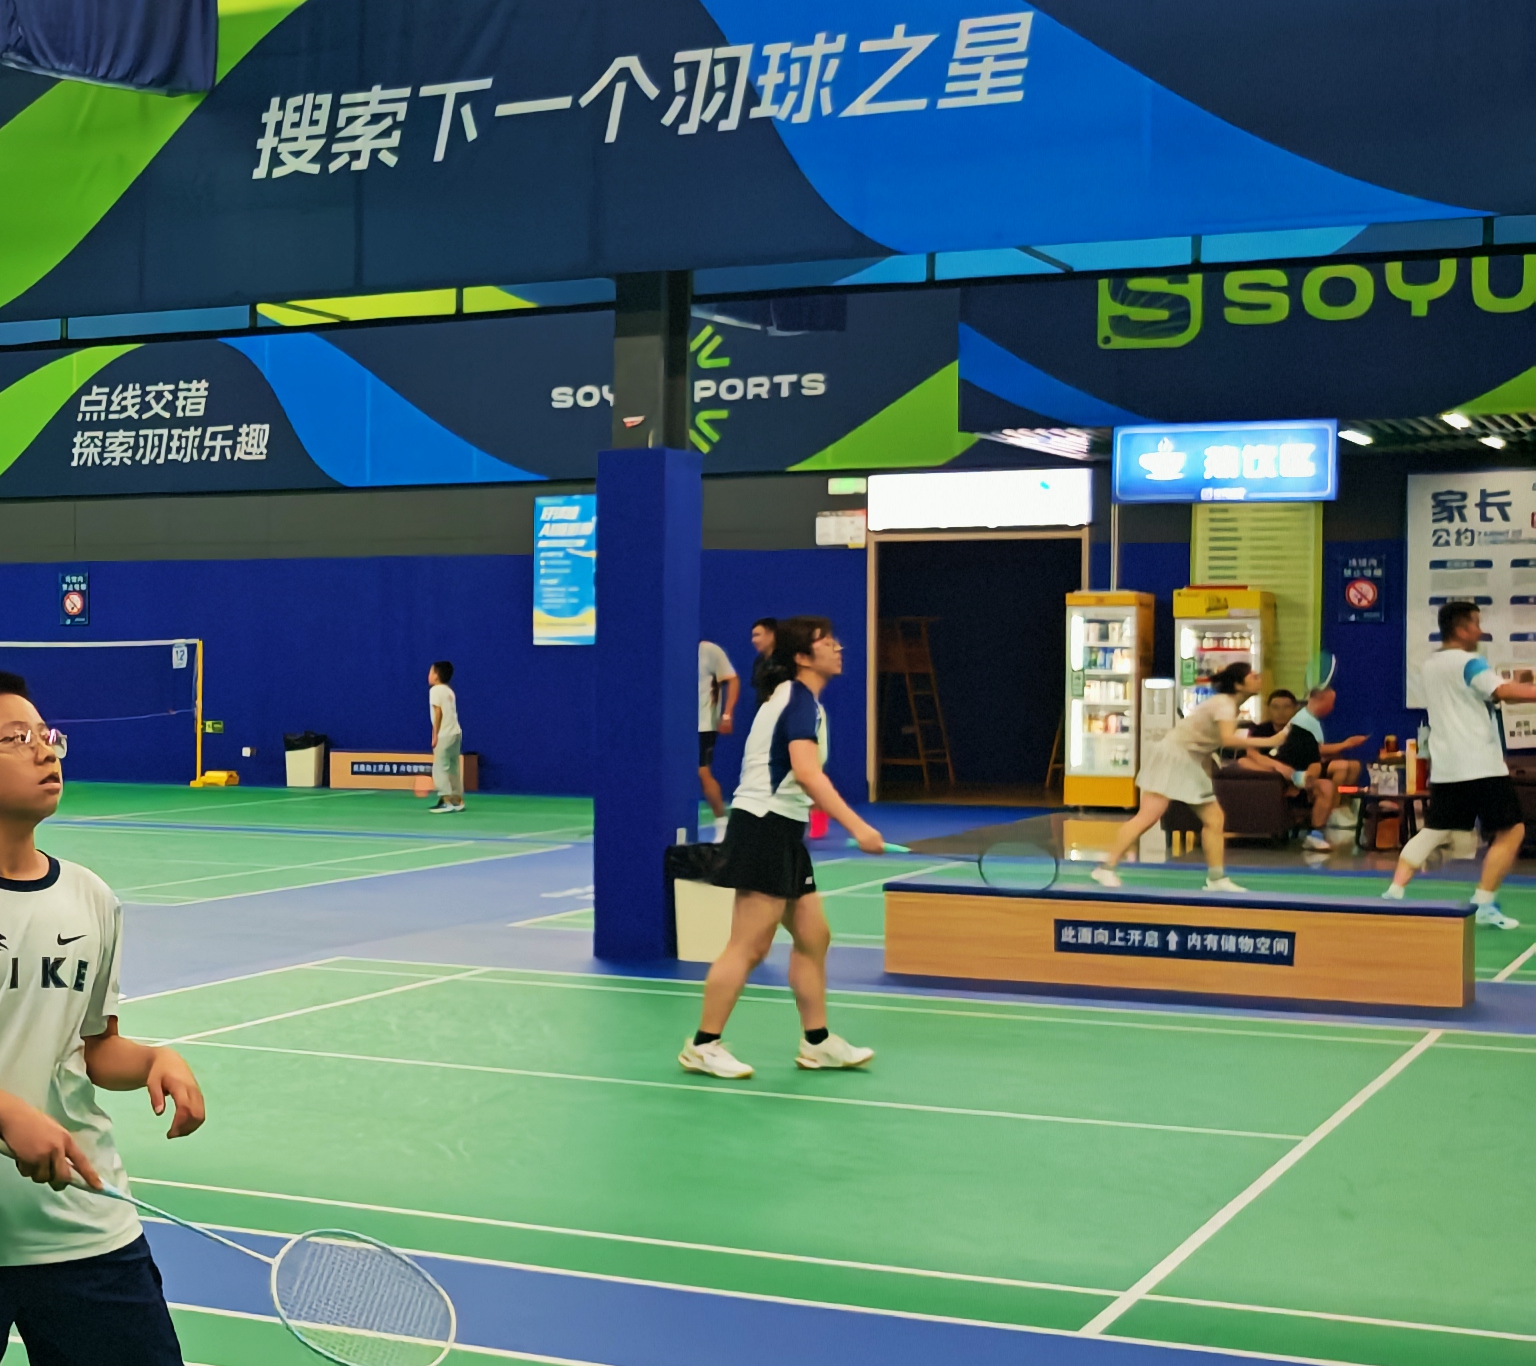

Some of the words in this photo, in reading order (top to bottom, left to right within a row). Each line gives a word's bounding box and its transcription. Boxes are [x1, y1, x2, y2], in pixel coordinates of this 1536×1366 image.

[252, 12, 1033, 179] 搜索下一个羽球之星
[1224, 254, 1536, 325] SOYU
[77, 379, 209, 422] 点线交错
[694, 373, 826, 403] PORTS
[71, 423, 270, 467] 探索羽球乐趣
